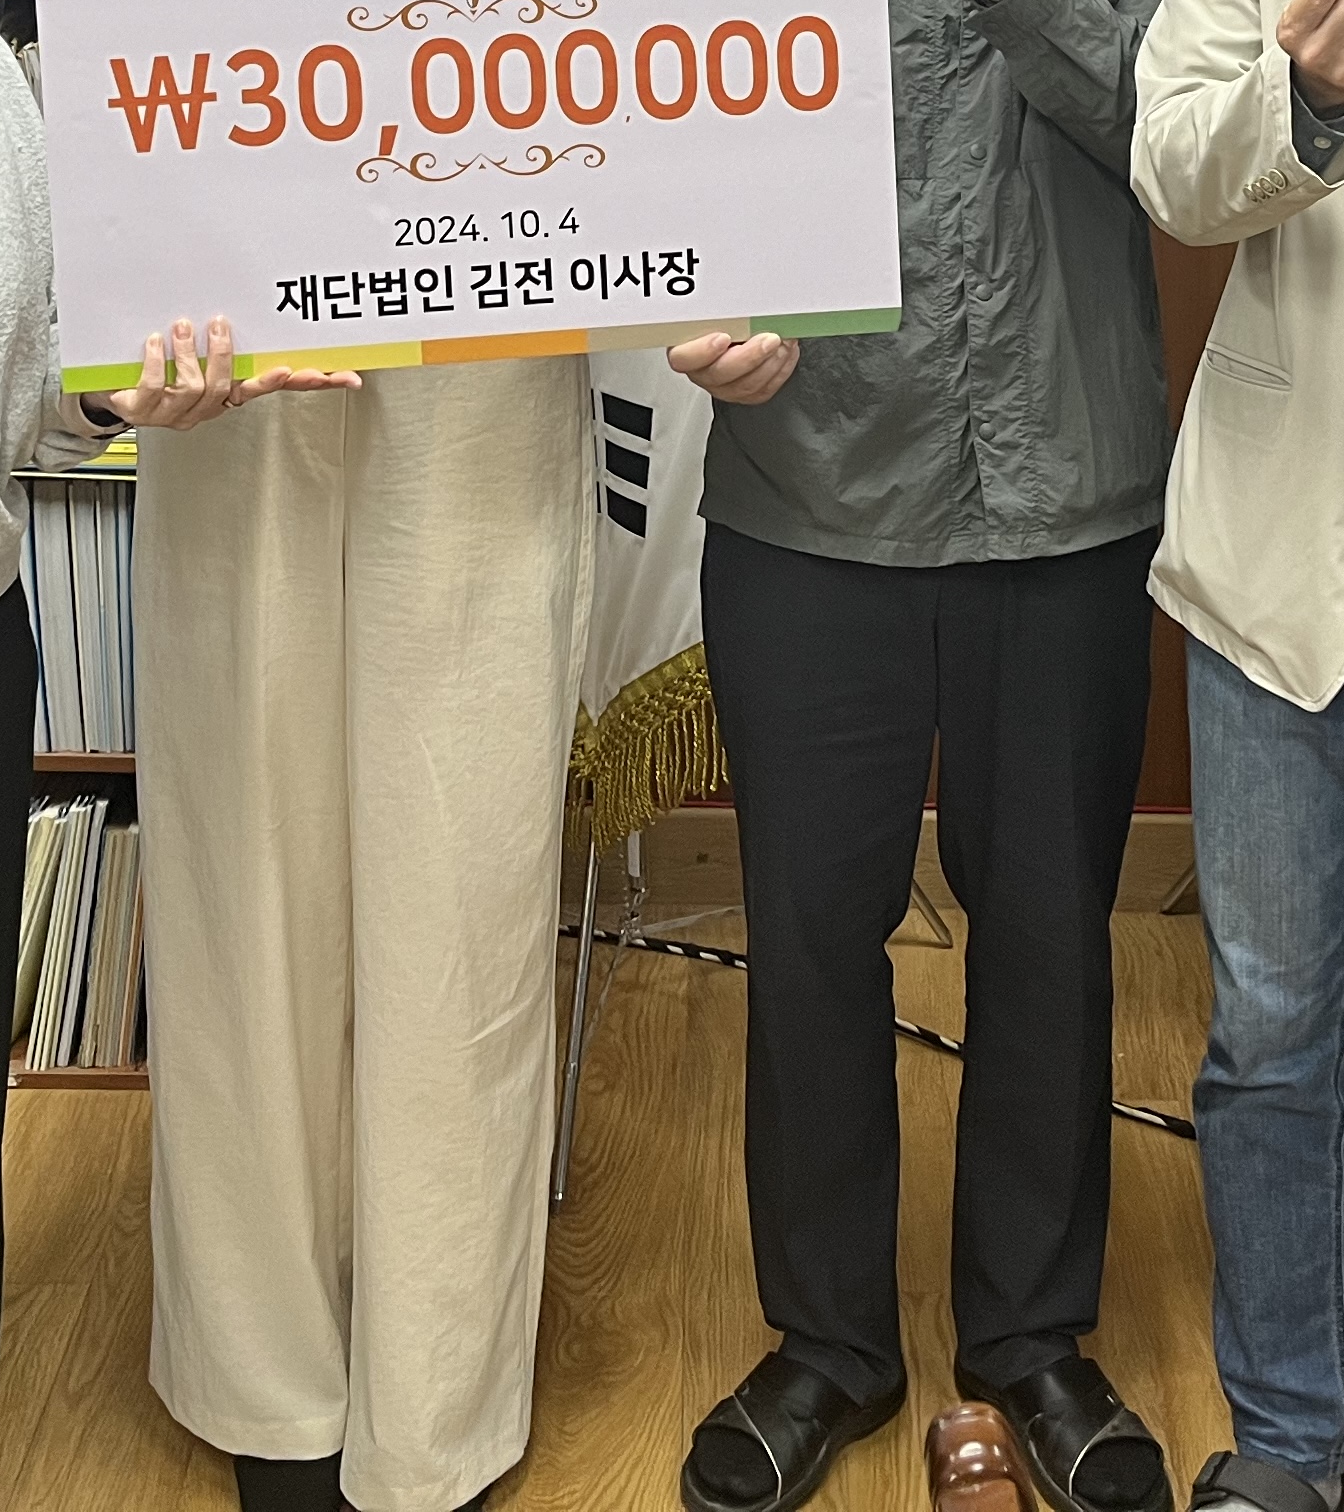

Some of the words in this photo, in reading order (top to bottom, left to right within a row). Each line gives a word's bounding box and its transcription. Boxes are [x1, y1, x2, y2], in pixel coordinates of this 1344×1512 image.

[394, 214, 490, 246] 2024.
[500, 209, 550, 239] 10.
[558, 207, 580, 235] 4
[276, 264, 455, 322] 재단법인
[469, 257, 555, 310] 김전
[569, 247, 700, 300] 이사장
